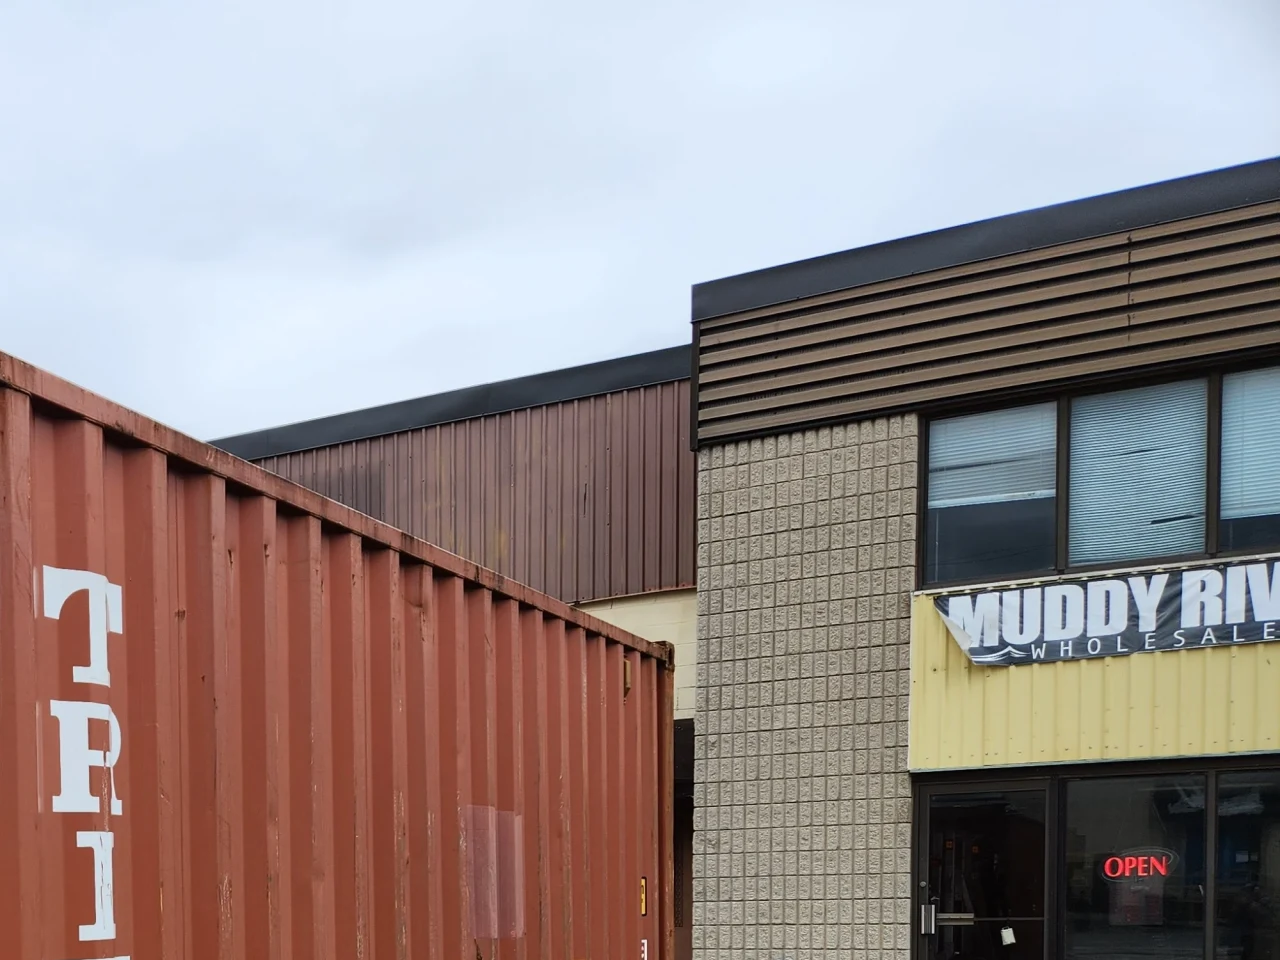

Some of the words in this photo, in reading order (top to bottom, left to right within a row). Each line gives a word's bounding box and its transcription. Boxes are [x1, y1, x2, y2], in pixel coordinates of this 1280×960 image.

[948, 573, 1170, 648] MUDDY
[1030, 621, 1277, 660] WHOLESALE
[1104, 855, 1168, 878] OPEN
